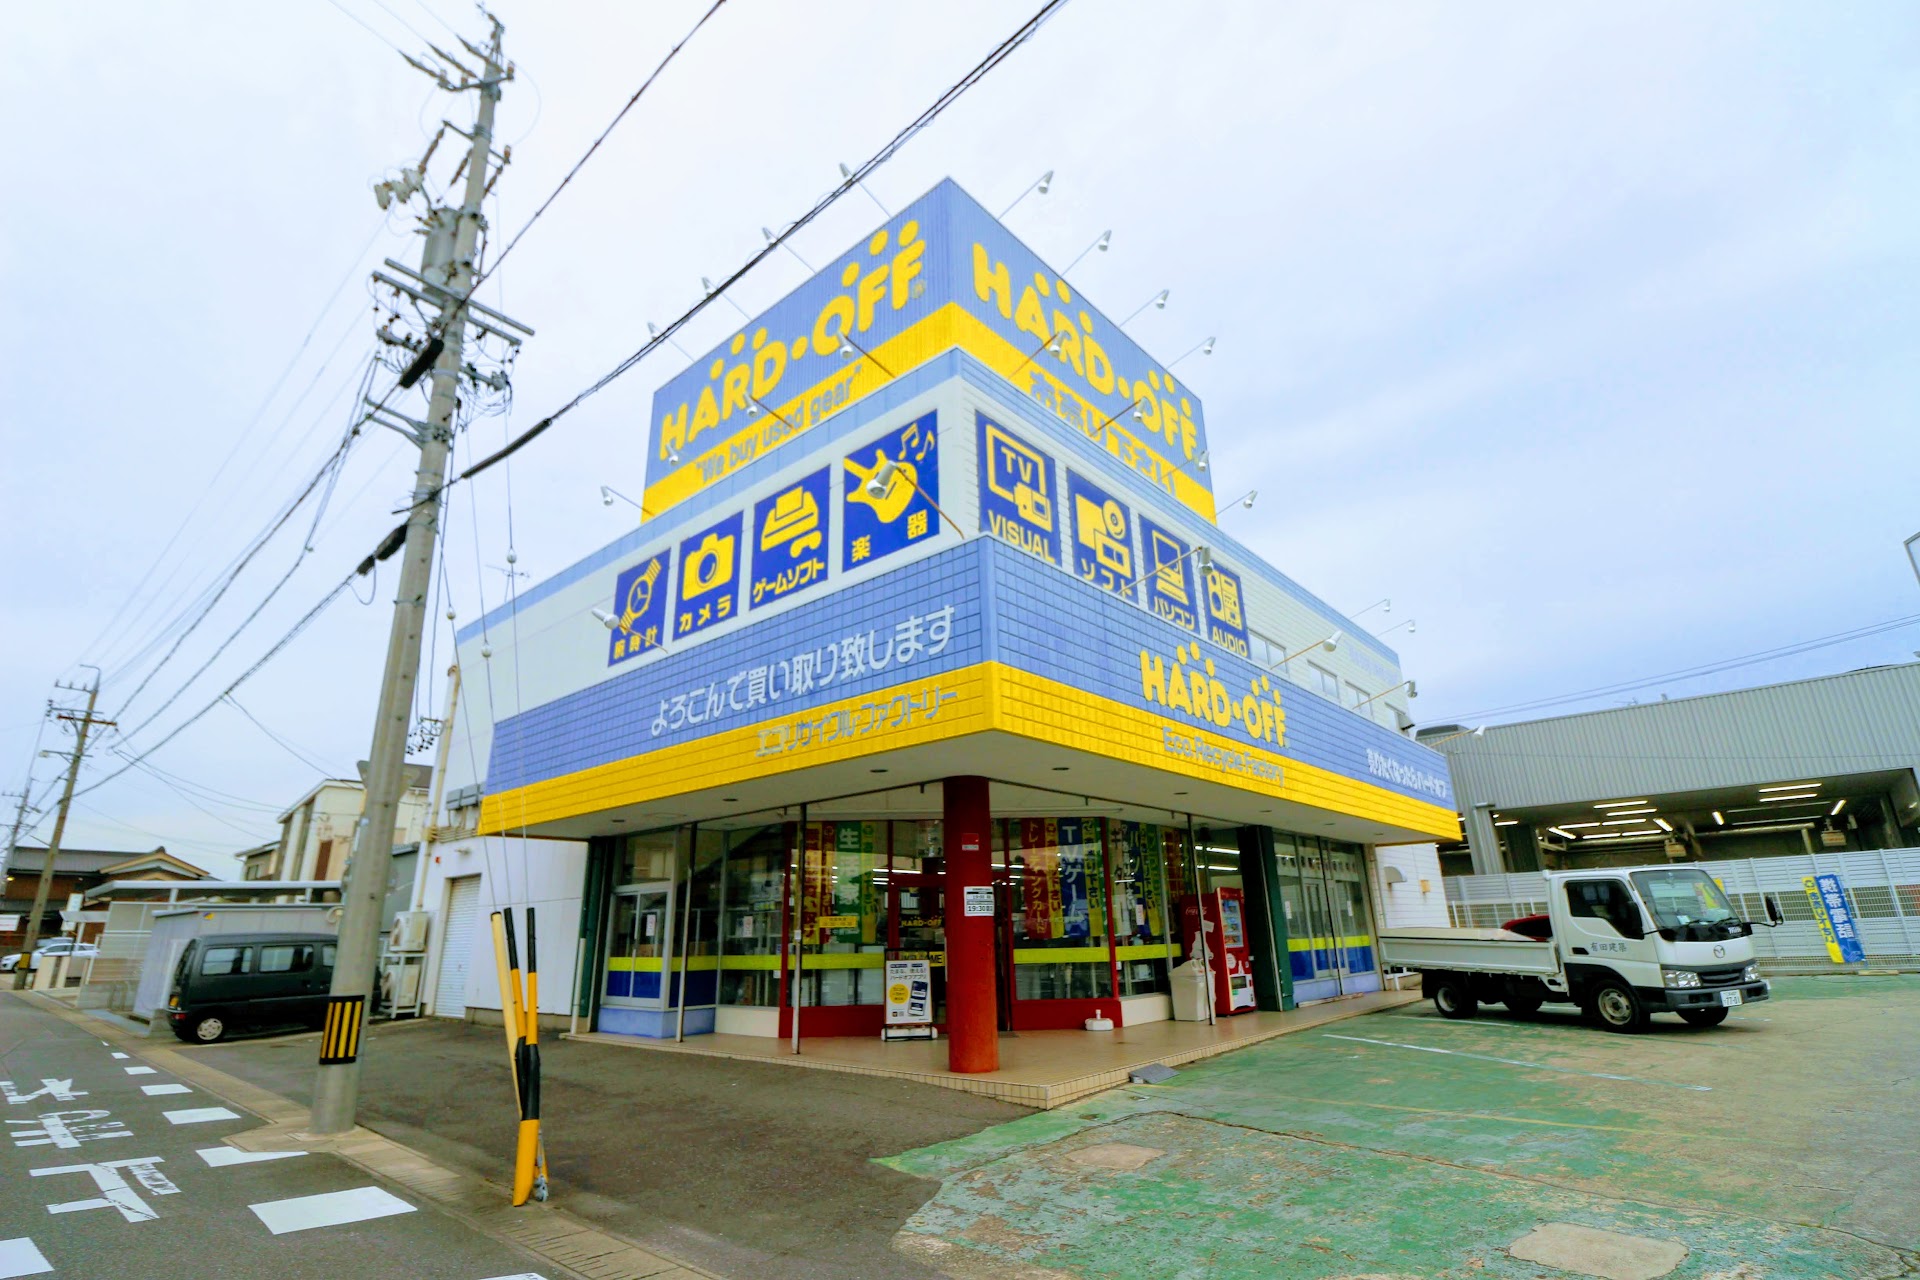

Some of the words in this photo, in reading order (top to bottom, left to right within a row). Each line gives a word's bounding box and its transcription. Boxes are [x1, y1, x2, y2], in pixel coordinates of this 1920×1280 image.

[730, 434, 757, 467] buy
[763, 400, 804, 447] used
[1001, 446, 1033, 484] TV
[988, 509, 1056, 564] VISUAL
[752, 557, 825, 603] ゲームソフト
[1081, 557, 1133, 601] ソフト
[678, 594, 732, 633] カメラ
[1153, 595, 1196, 631] パソコン
[1211, 625, 1248, 658] AUDIO
[651, 605, 955, 737] よろこんで買い取り致します
[1062, 825, 1085, 923] TVゲーム
